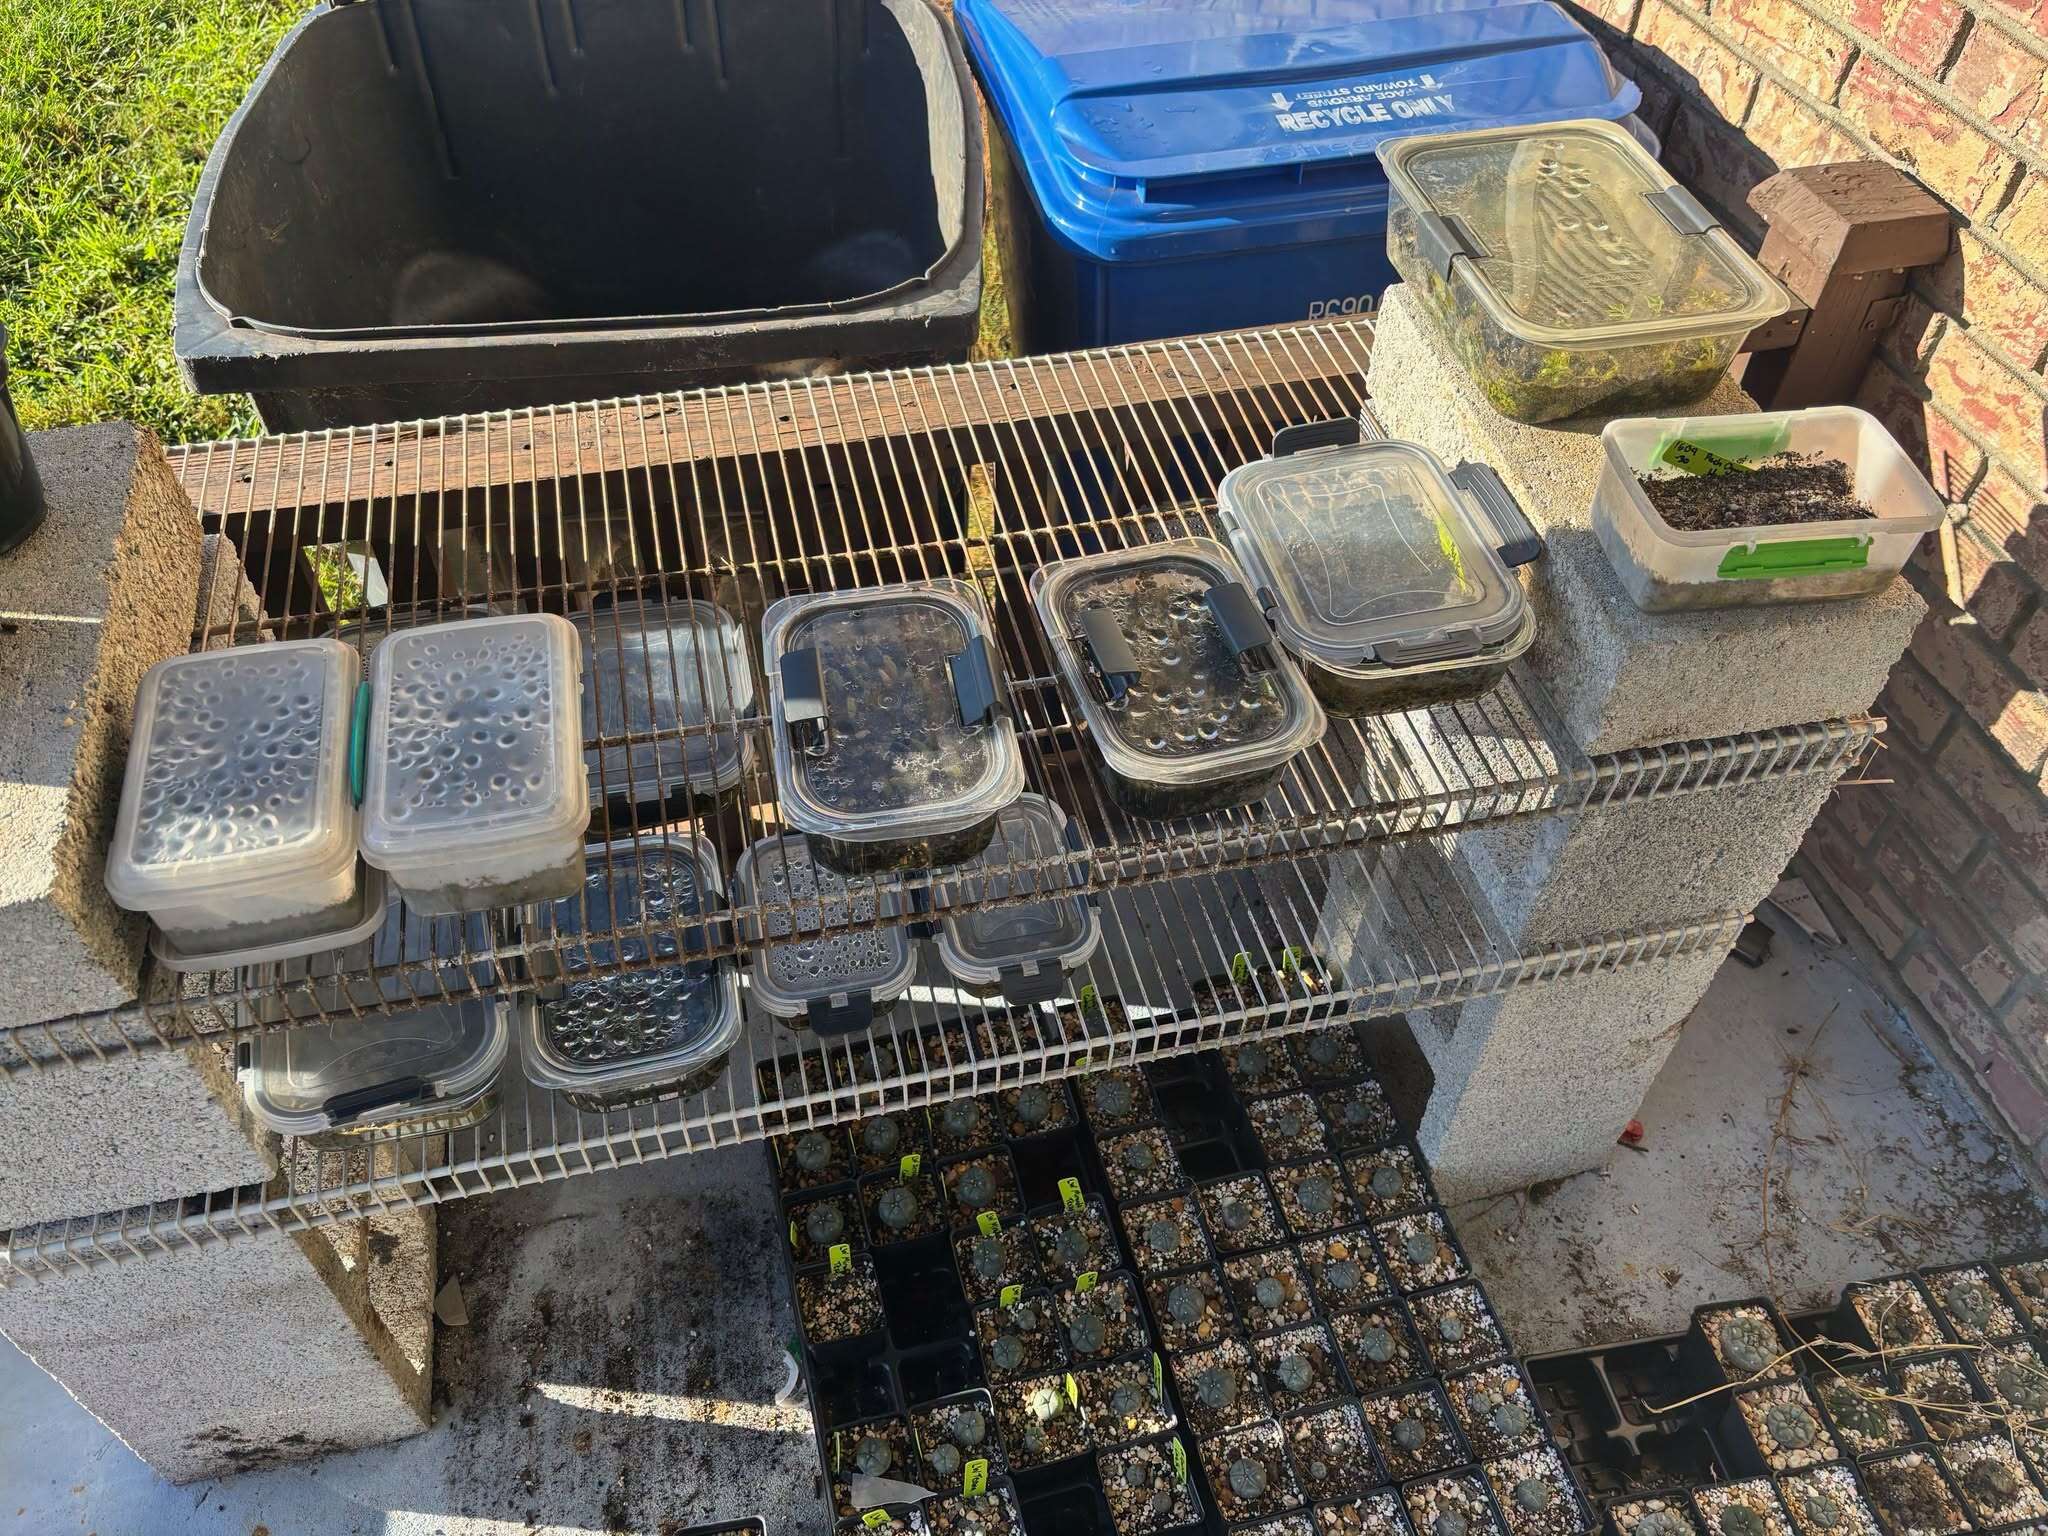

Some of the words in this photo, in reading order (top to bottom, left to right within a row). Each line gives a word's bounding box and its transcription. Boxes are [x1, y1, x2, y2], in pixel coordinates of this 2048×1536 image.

[1352, 79, 1418, 94] TOWARD
[1295, 87, 1351, 101] STREET
[1306, 94, 1373, 108] ARROWS
[1275, 102, 1393, 132] RECYCLE
[1391, 94, 1457, 119] ONLY
